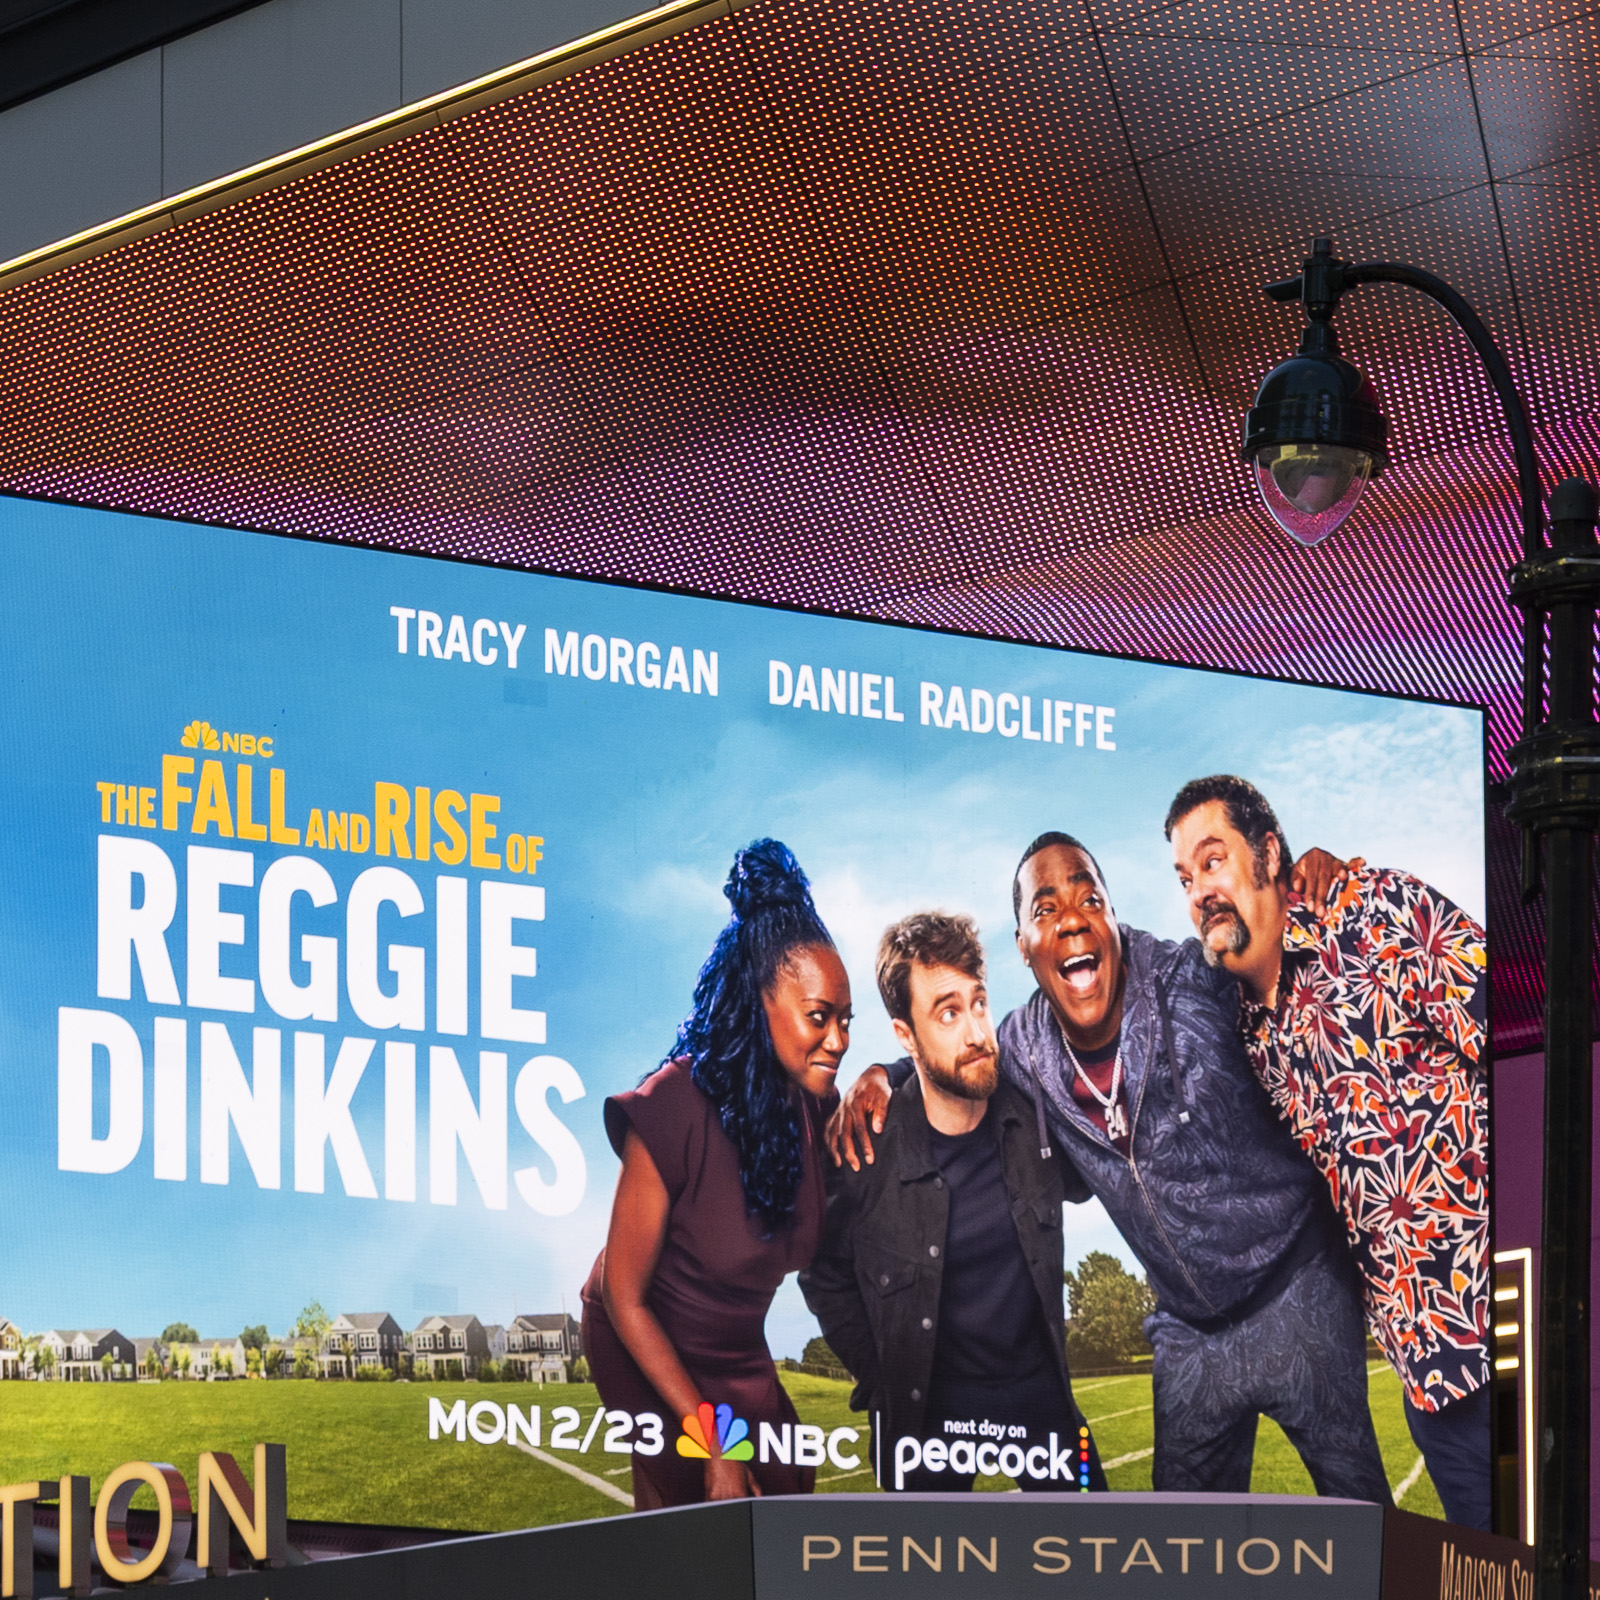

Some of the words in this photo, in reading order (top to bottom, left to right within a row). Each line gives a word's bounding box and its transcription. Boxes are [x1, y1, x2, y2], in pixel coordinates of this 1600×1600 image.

[391, 606, 526, 669] TRACY
[544, 628, 718, 696] MORGAN
[769, 660, 904, 723] DANIEL
[920, 682, 1117, 751] RADCLIFFE
[222, 731, 275, 758] NBC
[97, 781, 158, 830] THE
[161, 755, 301, 847] FALL
[306, 809, 370, 854] AND
[375, 782, 501, 868] RISE
[506, 833, 544, 875] OF
[97, 835, 547, 1044] REGGIE
[57, 1007, 588, 1217] DINKINS
[428, 1398, 541, 1447] MON
[550, 1405, 665, 1457] 2/23
[759, 1423, 860, 1470] NBC
[944, 1419, 976, 1435] next
[979, 1419, 1005, 1440] day
[1009, 1425, 1026, 1438] on
[894, 1431, 1074, 1491] peacock
[803, 1536, 998, 1573] PENN
[1032, 1537, 1334, 1576] STATION
